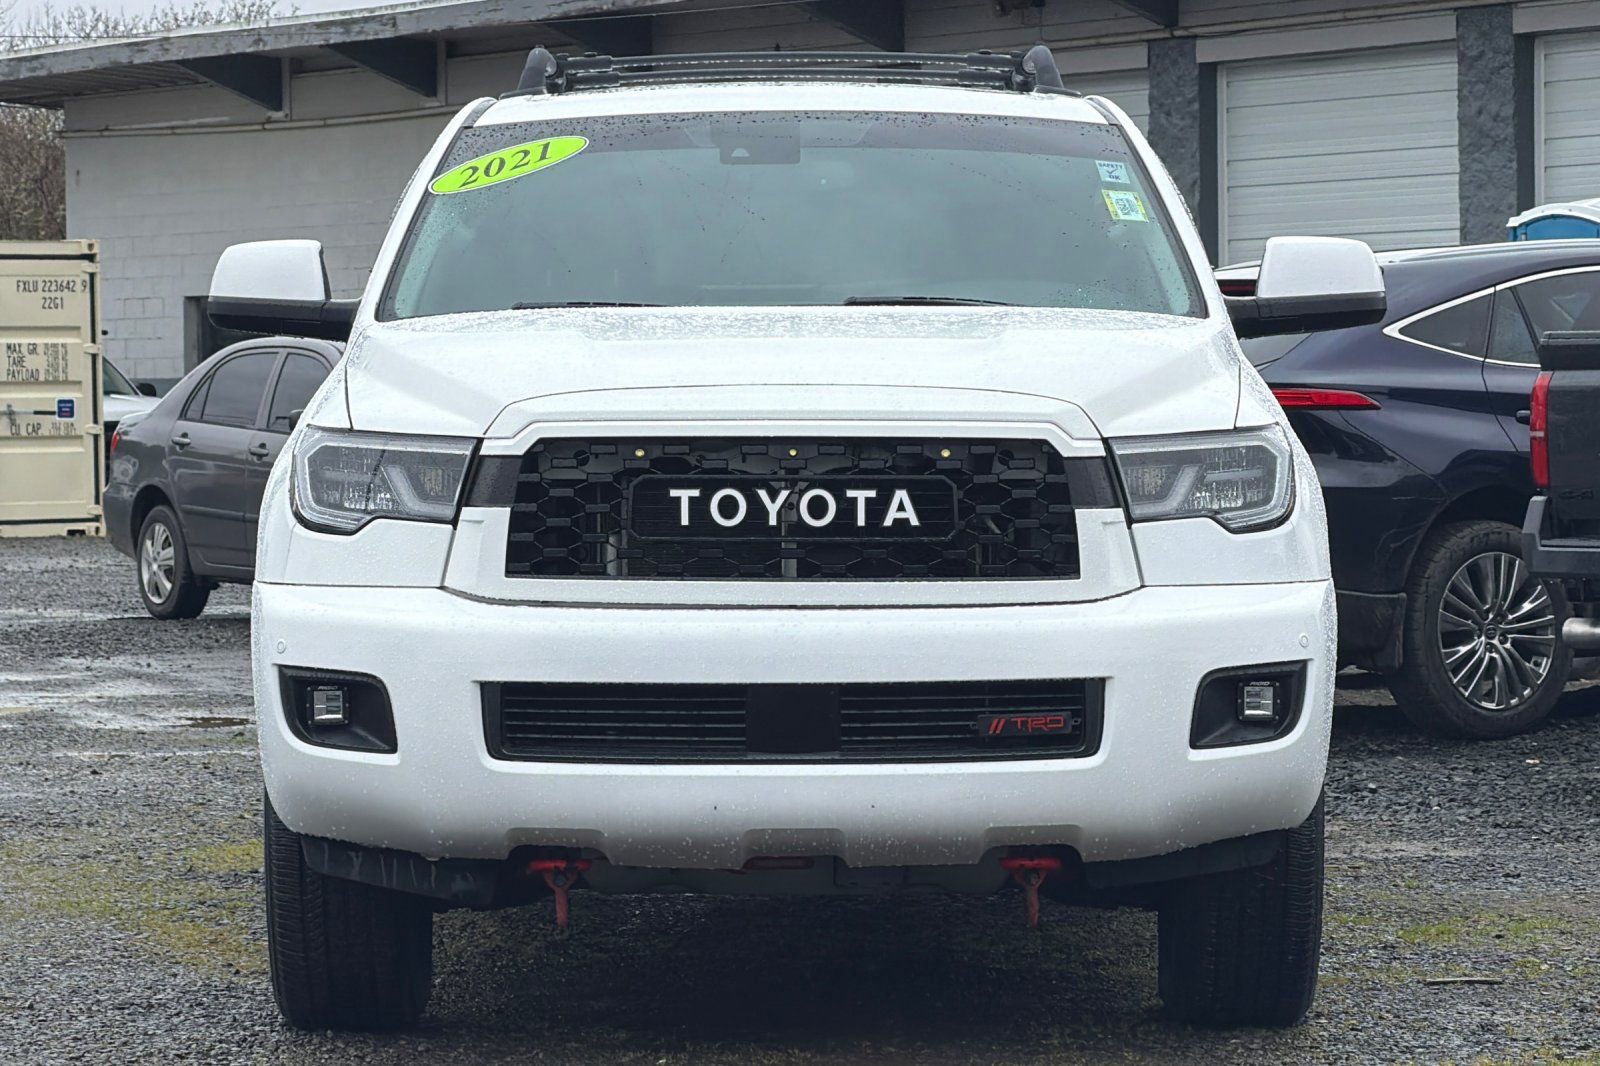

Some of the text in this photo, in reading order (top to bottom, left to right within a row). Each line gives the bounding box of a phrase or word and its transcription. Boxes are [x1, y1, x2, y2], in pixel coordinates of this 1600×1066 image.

[458, 141, 553, 188] 2021
[16, 279, 88, 293] FXLU 223642 9
[41, 297, 64, 310] 22G1
[7, 355, 26, 369] TARE
[7, 368, 40, 381] PAYLOAD
[669, 488, 920, 527] TOYOTA
[1010, 716, 1064, 733] TRD
